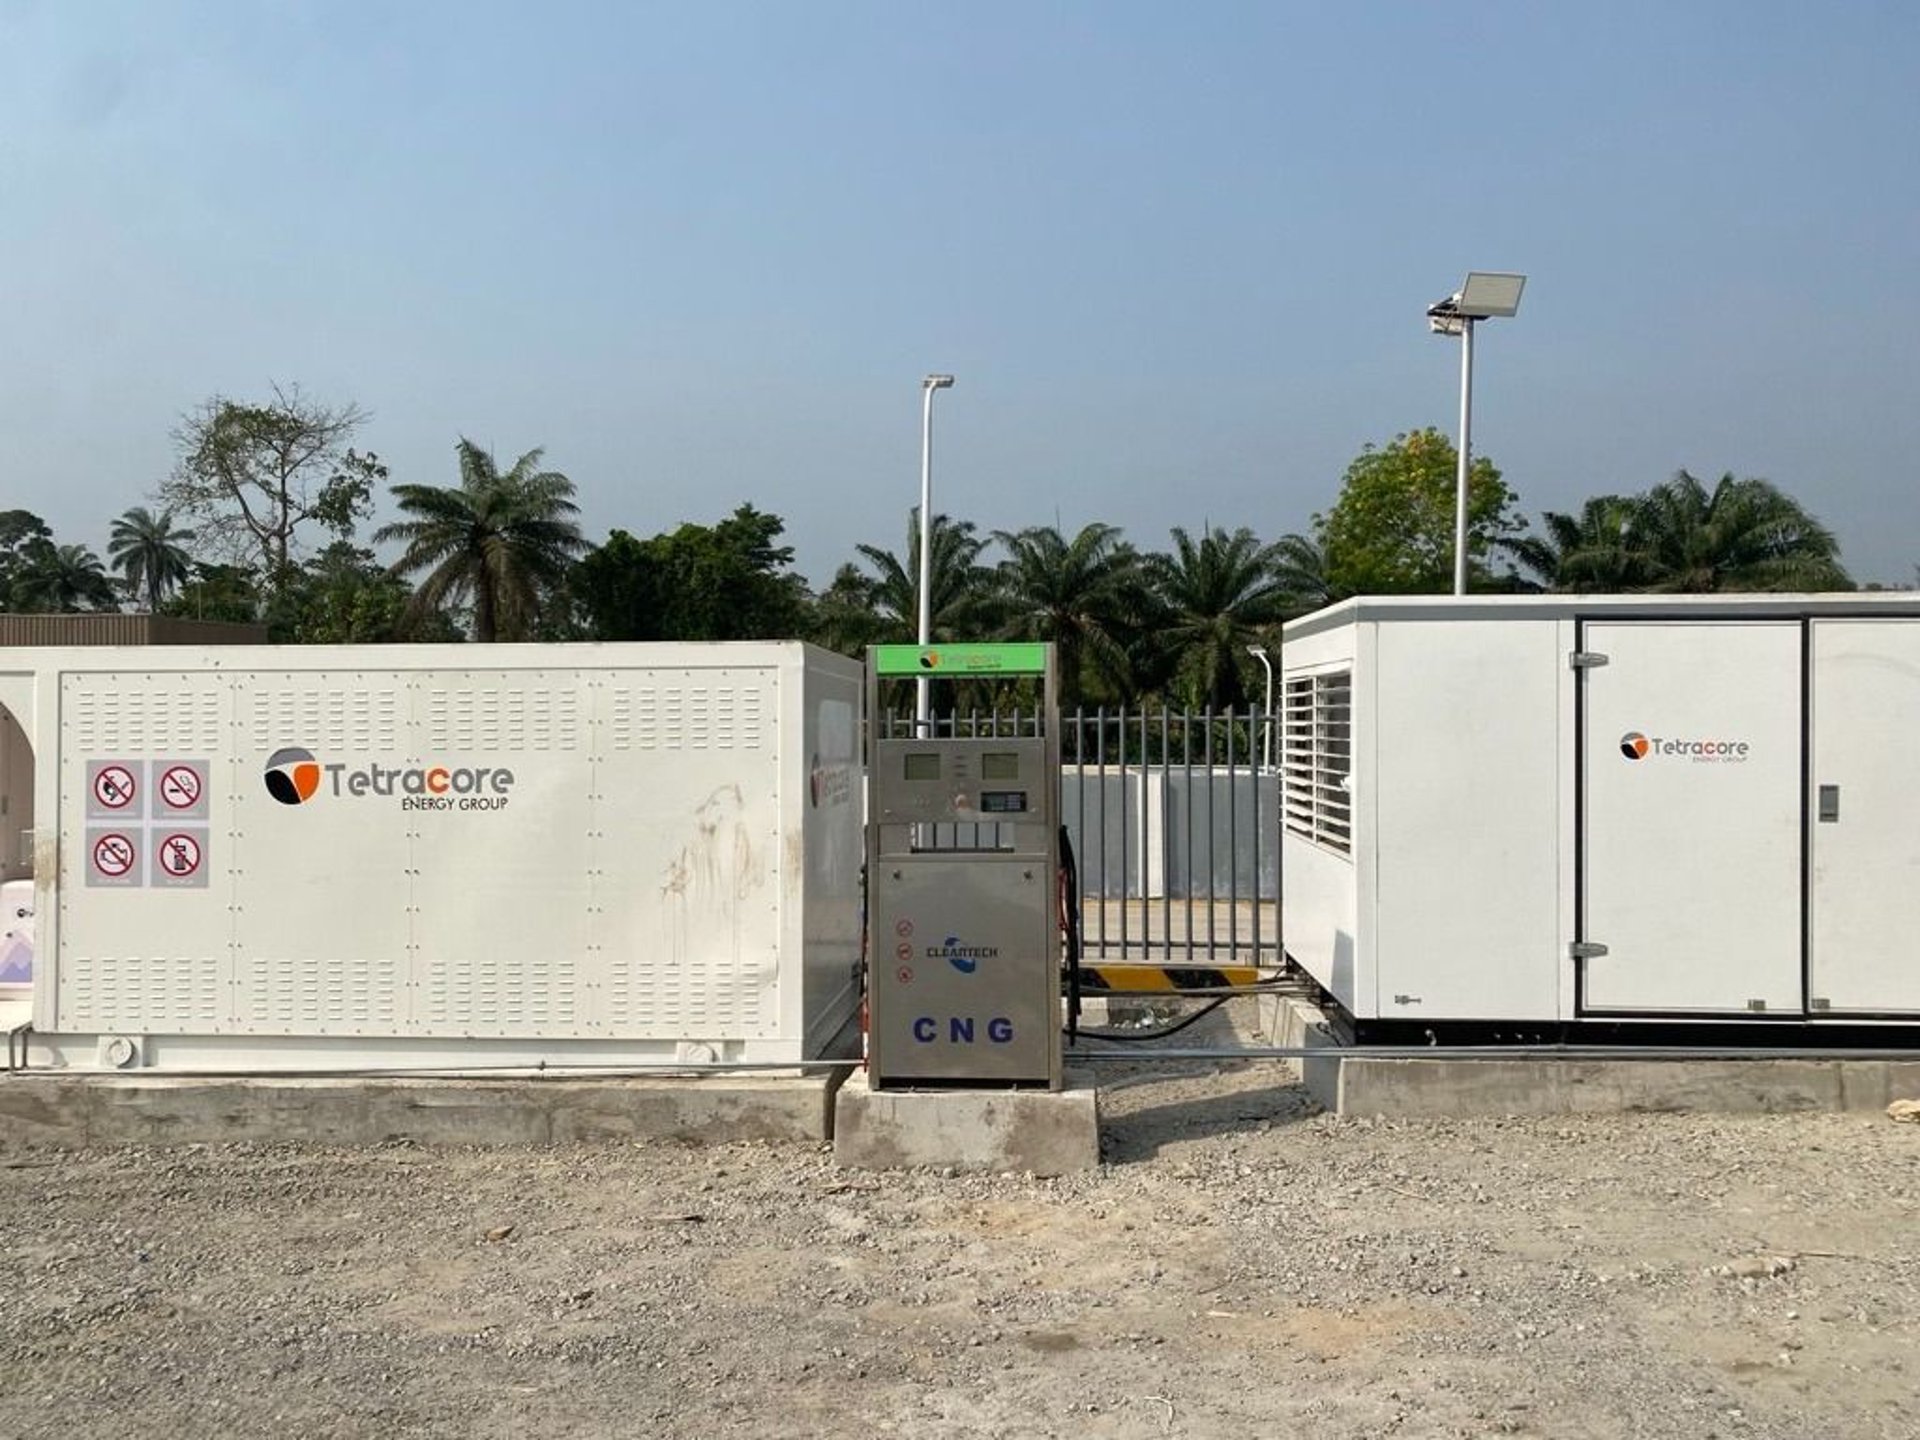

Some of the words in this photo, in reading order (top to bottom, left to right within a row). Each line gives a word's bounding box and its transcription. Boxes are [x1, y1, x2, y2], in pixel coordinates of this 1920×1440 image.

[1652, 738, 1749, 755] Tetracore
[325, 763, 515, 797] Tetracore
[402, 799, 455, 811] ENERGY
[458, 798, 509, 810] GROUP
